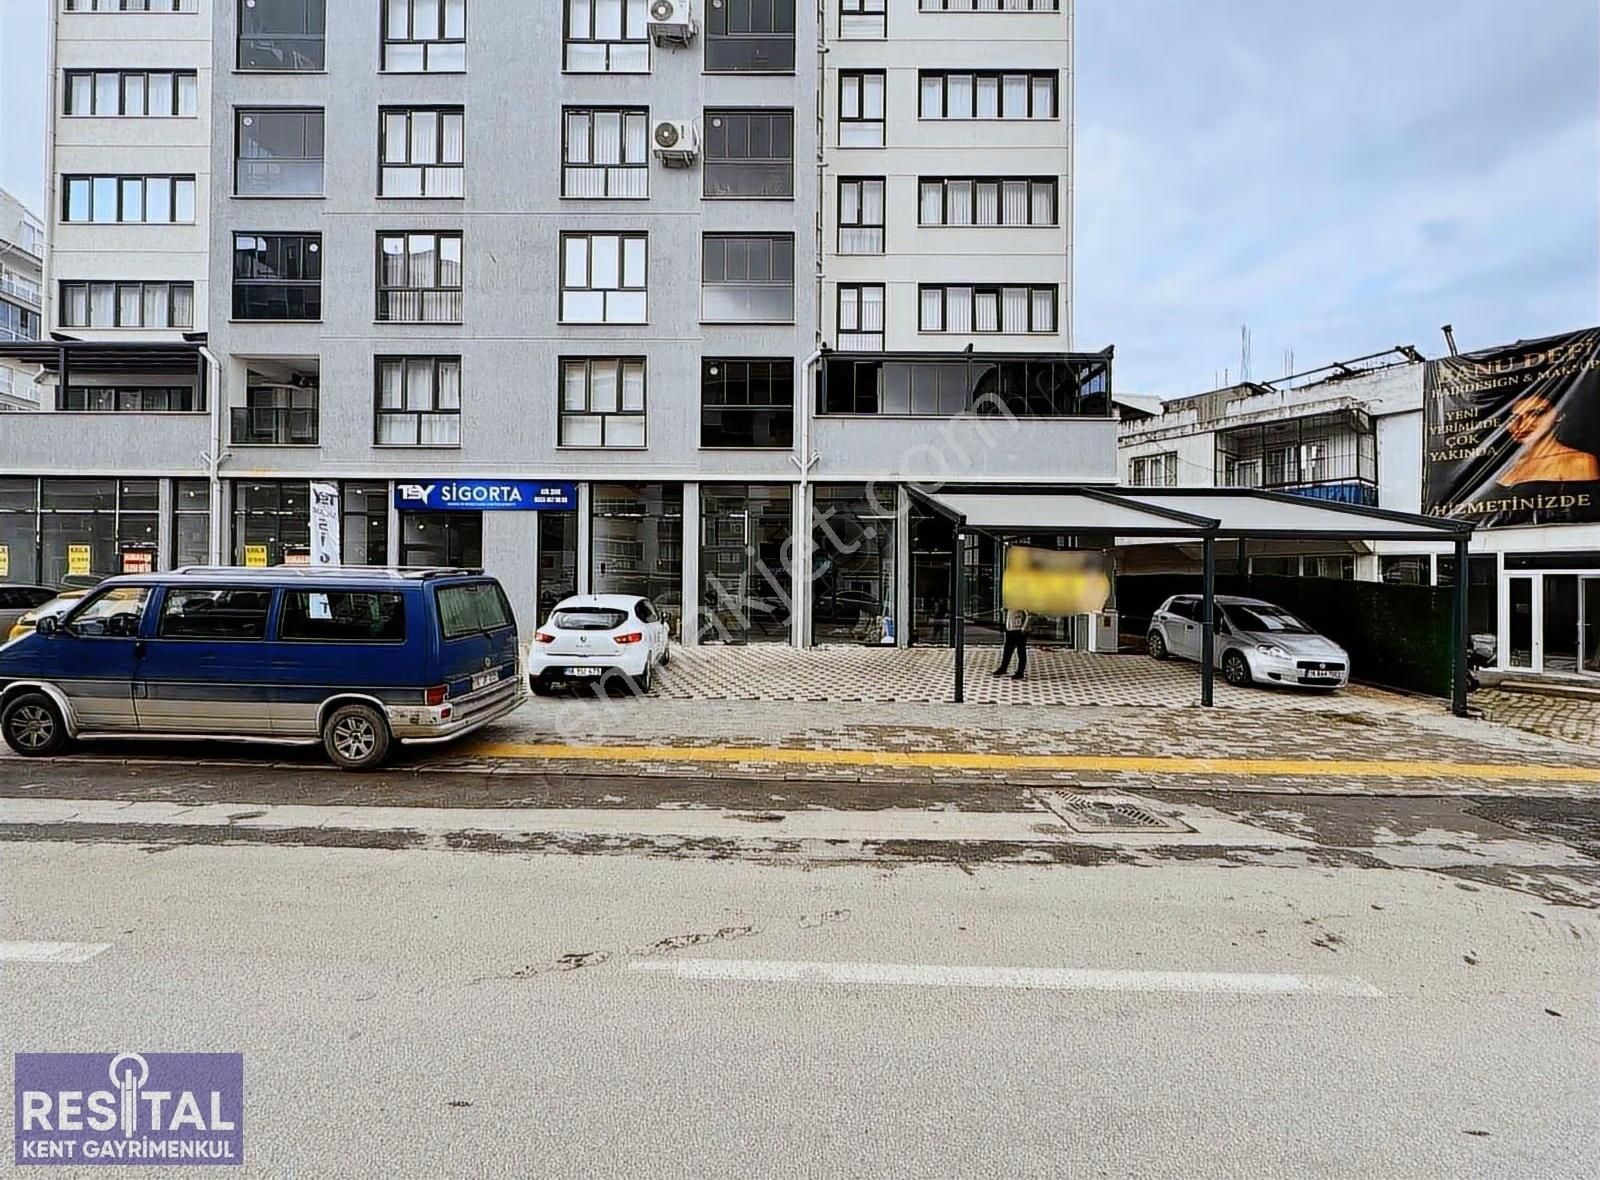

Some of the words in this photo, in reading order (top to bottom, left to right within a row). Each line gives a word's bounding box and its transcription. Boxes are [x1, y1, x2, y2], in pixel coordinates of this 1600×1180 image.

[1446, 434, 1480, 448] ÇOK
[1429, 446, 1497, 462] YAKINDA
[441, 482, 522, 502] SİGORTA
